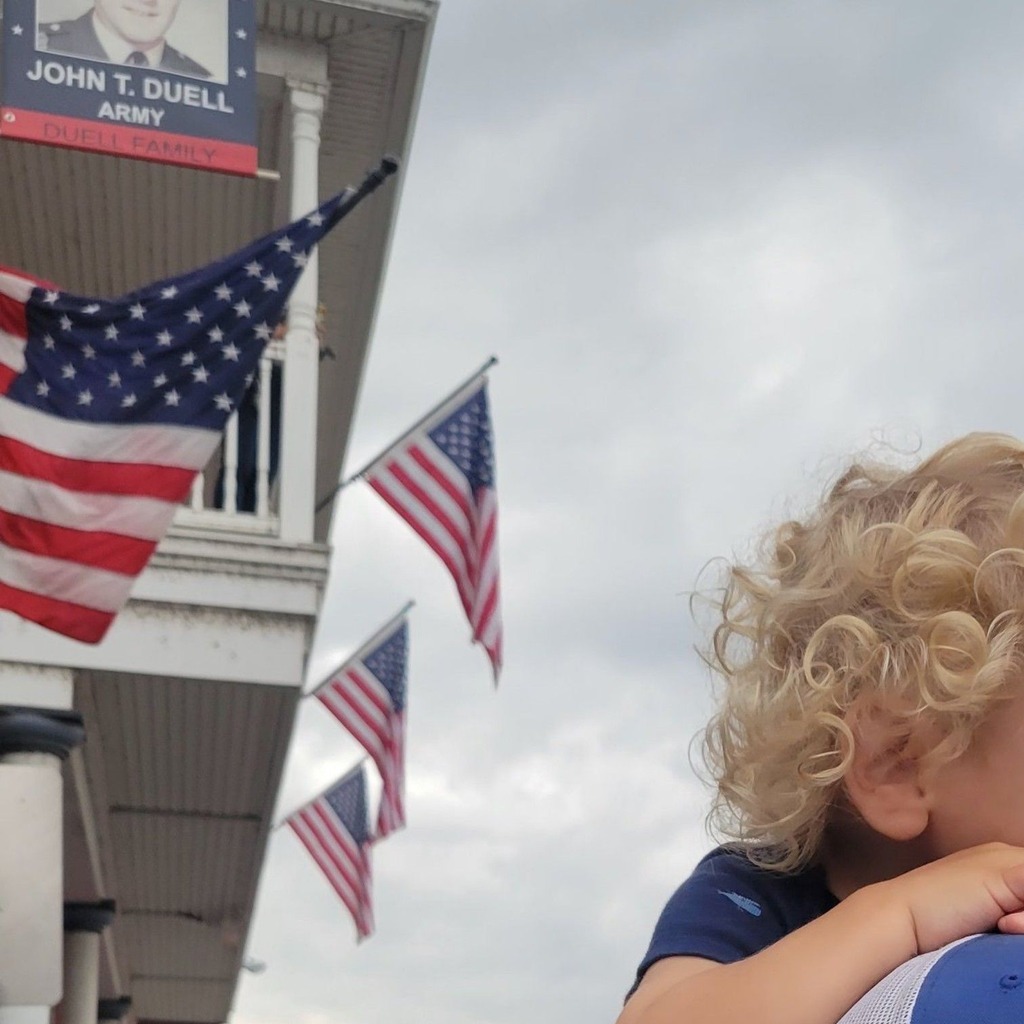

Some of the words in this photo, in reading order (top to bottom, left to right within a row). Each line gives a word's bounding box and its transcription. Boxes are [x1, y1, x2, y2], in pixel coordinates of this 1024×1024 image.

[27, 59, 106, 92] JOHN
[113, 73, 136, 97] T.
[142, 78, 235, 114] DUELL
[97, 101, 165, 127] ARMY
[43, 122, 120, 150] DUELL
[132, 136, 217, 164] FAMILY
